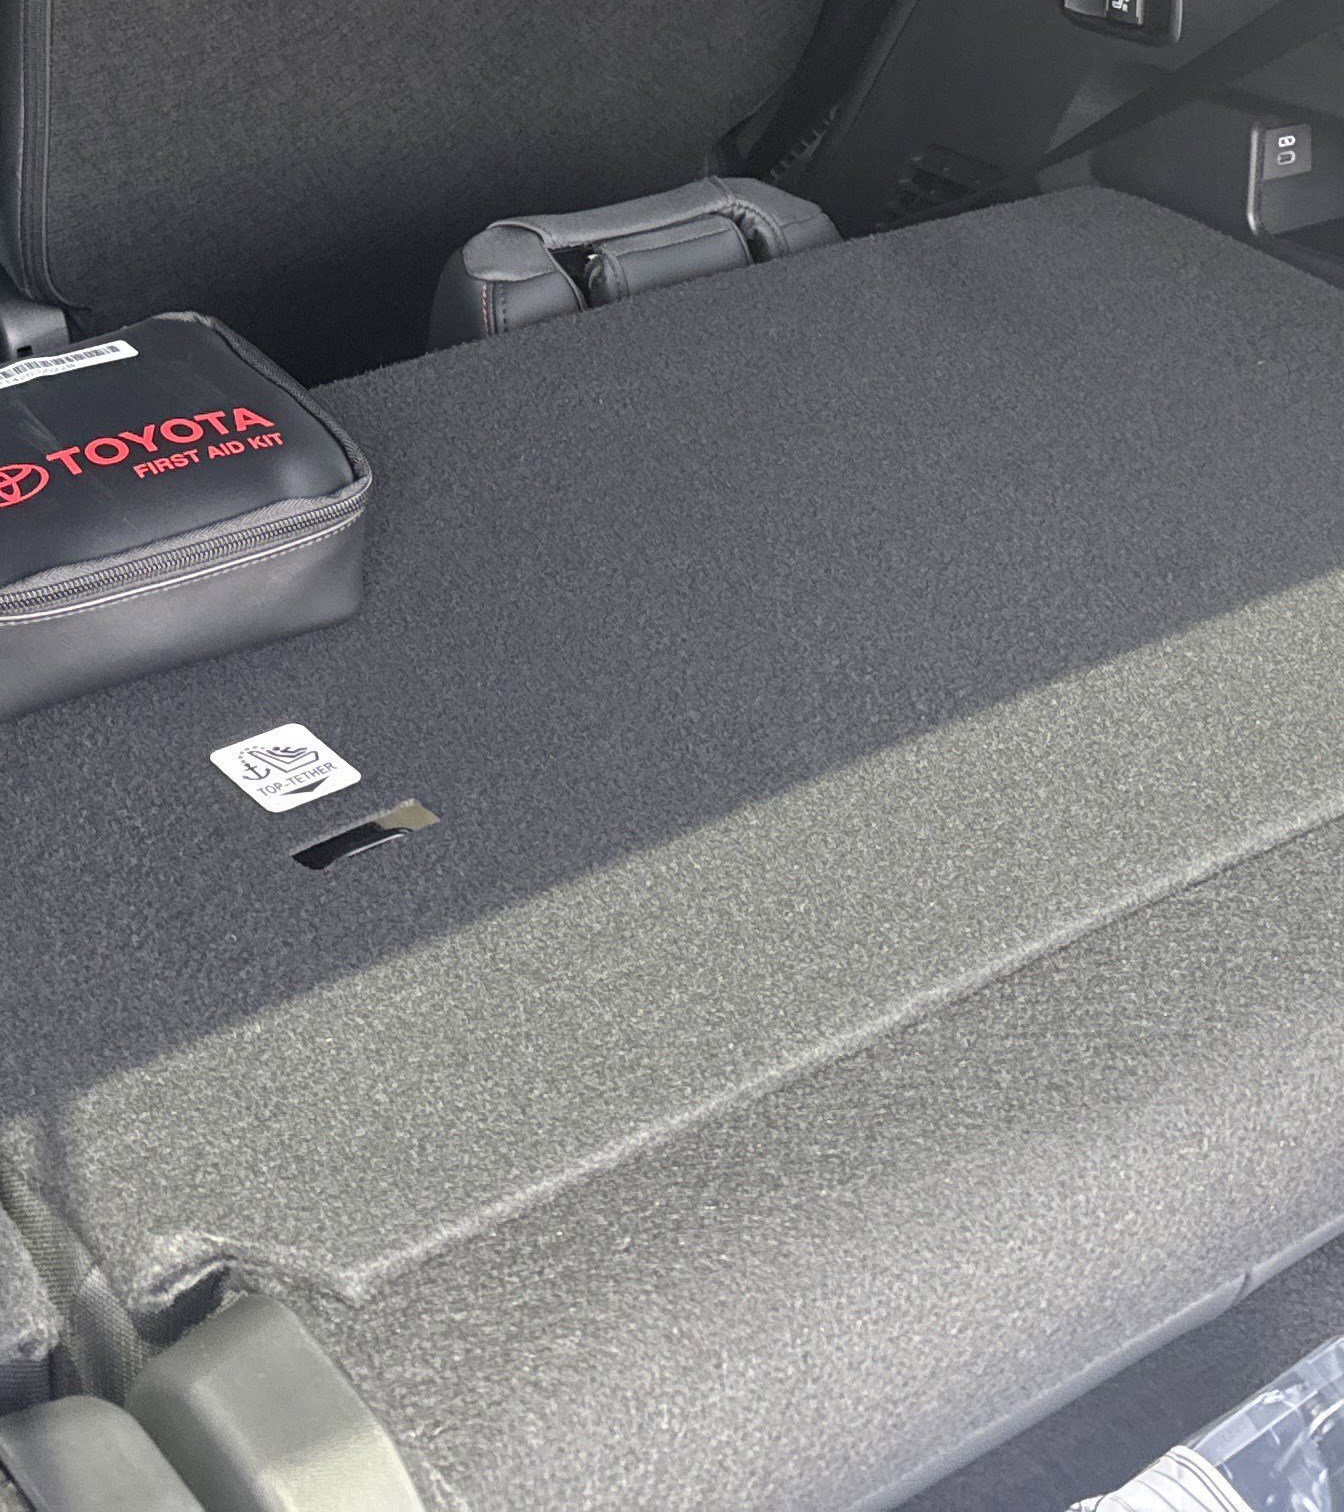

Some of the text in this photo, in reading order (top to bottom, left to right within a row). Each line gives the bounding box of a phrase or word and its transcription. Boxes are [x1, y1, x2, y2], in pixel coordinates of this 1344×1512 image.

[46, 406, 275, 476] TOYOTA
[133, 432, 284, 478] FIRST AID KIT
[257, 762, 338, 798] TOP-TETHER
